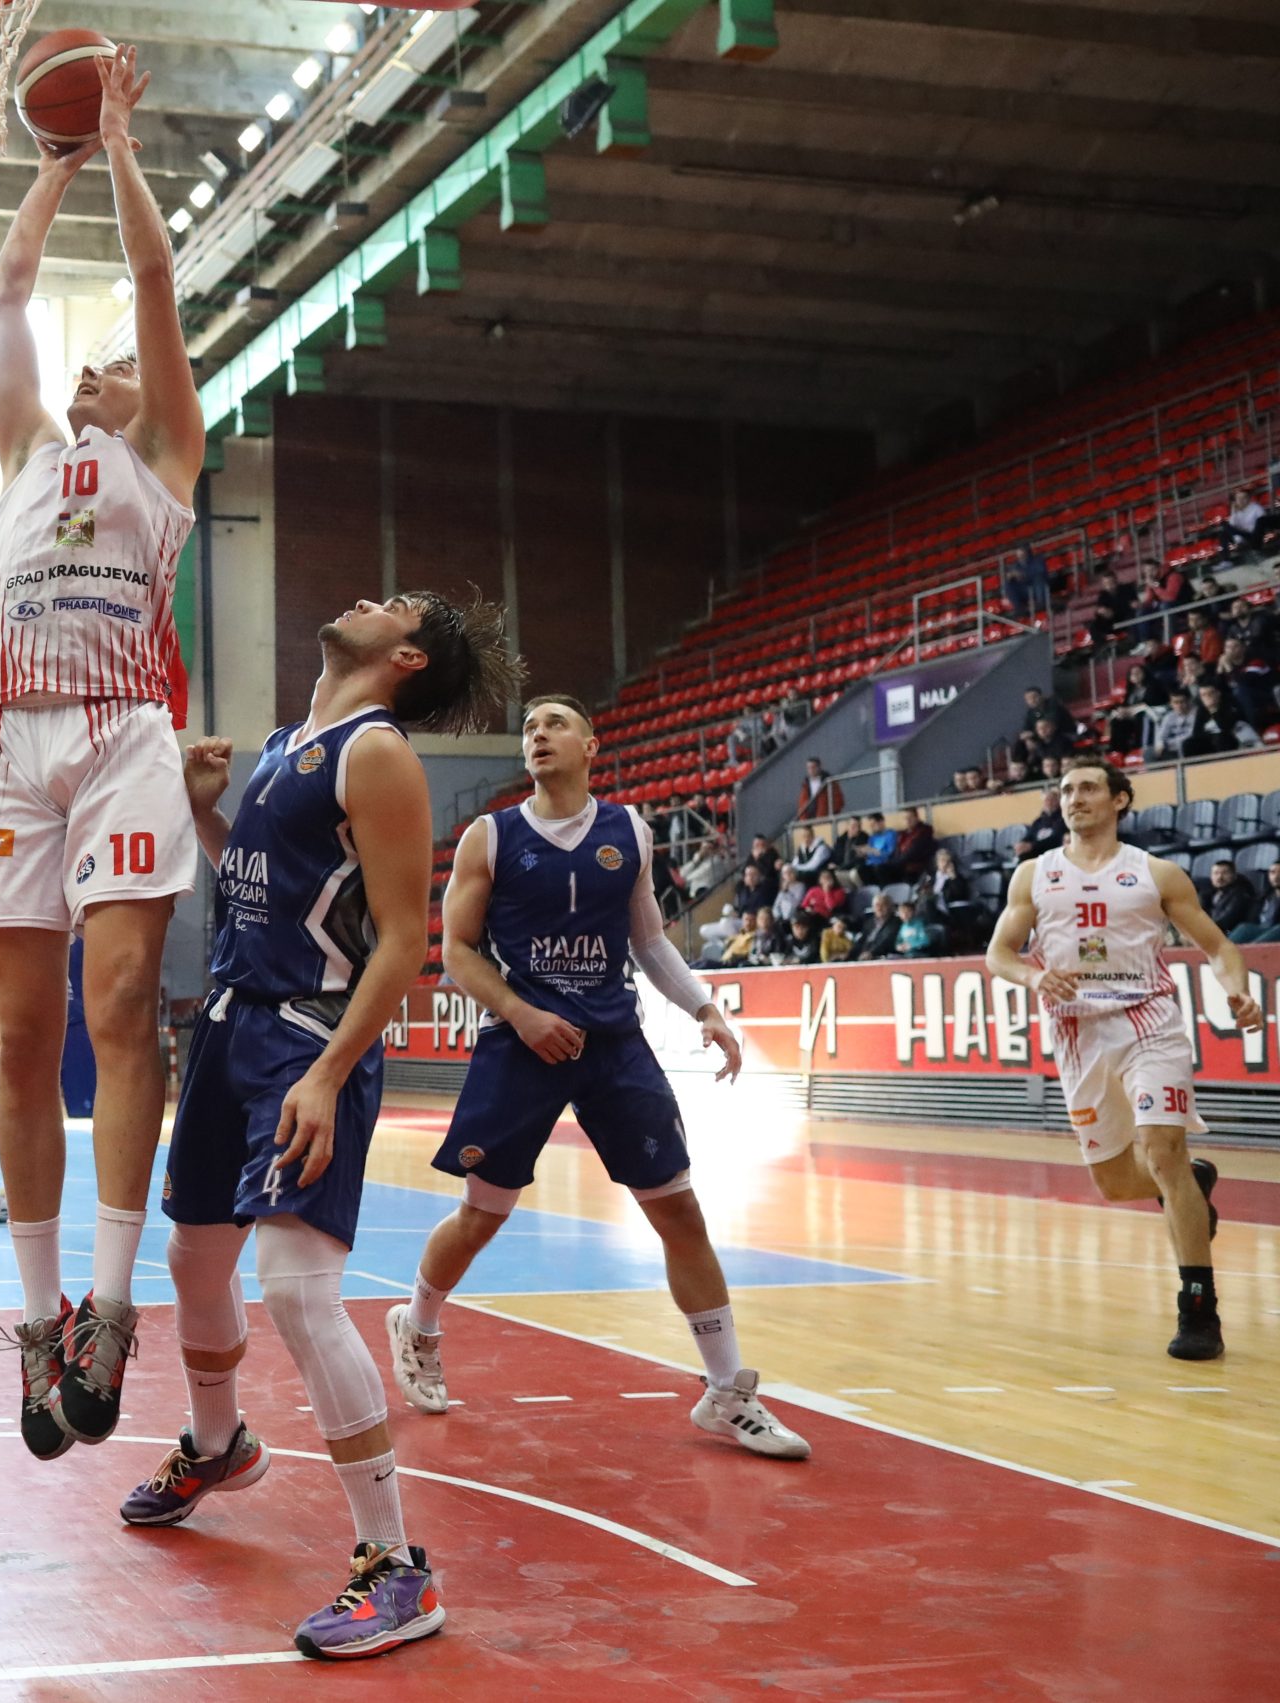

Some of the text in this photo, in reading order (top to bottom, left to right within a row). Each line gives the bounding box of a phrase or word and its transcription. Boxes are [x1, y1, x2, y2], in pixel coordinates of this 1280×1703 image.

[63, 459, 98, 498] 10
[6, 564, 149, 589] GRAD KRAGUJEVAC
[109, 832, 154, 876] 10
[568, 871, 577, 913] 1
[1075, 902, 1107, 928] 30
[531, 936, 607, 959] МАЛА
[530, 959, 607, 972] КОЛУБАРА
[433, 991, 479, 1049] ГРА
[799, 975, 836, 1055] И
[1162, 1086, 1188, 1113] 30
[262, 1153, 282, 1206] 4
